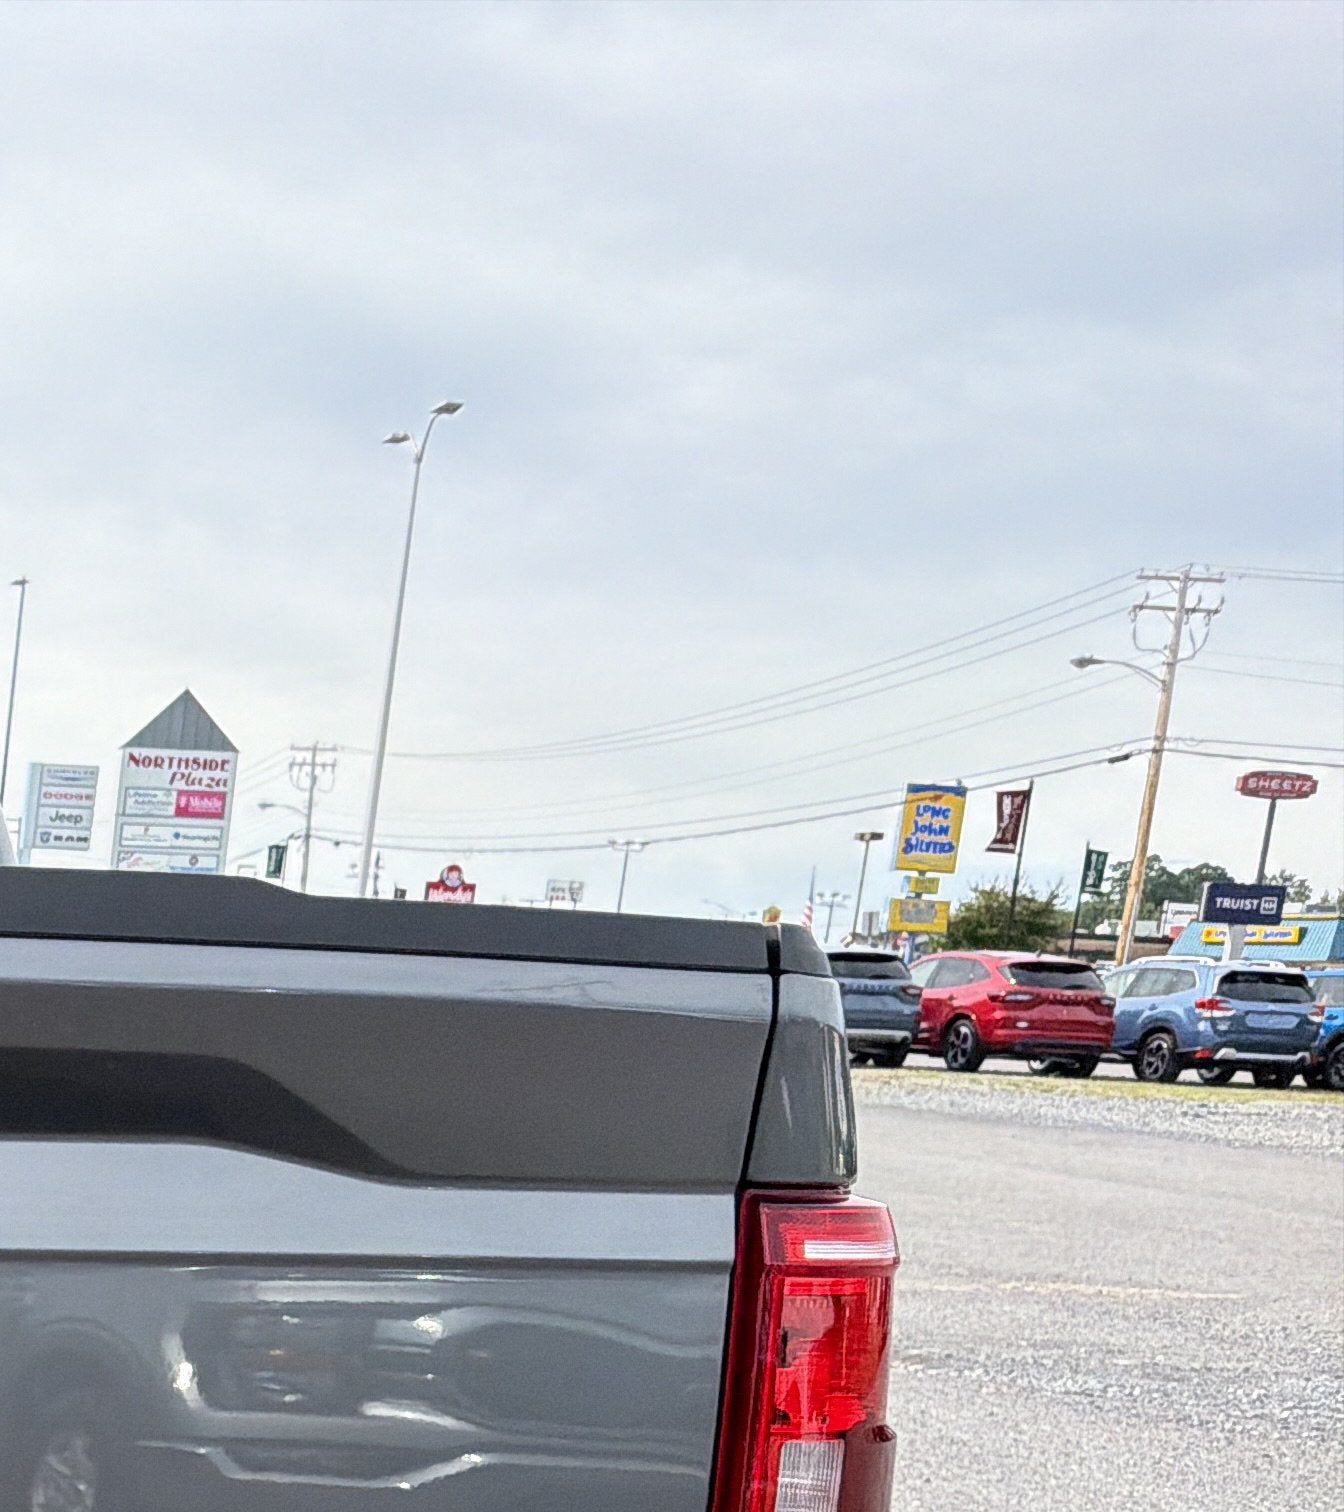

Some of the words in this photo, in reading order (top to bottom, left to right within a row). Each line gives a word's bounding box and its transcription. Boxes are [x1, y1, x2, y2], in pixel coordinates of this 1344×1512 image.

[169, 771, 228, 788] Plaza
[1247, 777, 1313, 792] SHEETZ
[49, 810, 84, 826] Jeep
[916, 804, 952, 820] LONG
[1215, 896, 1260, 911] TRUIST
